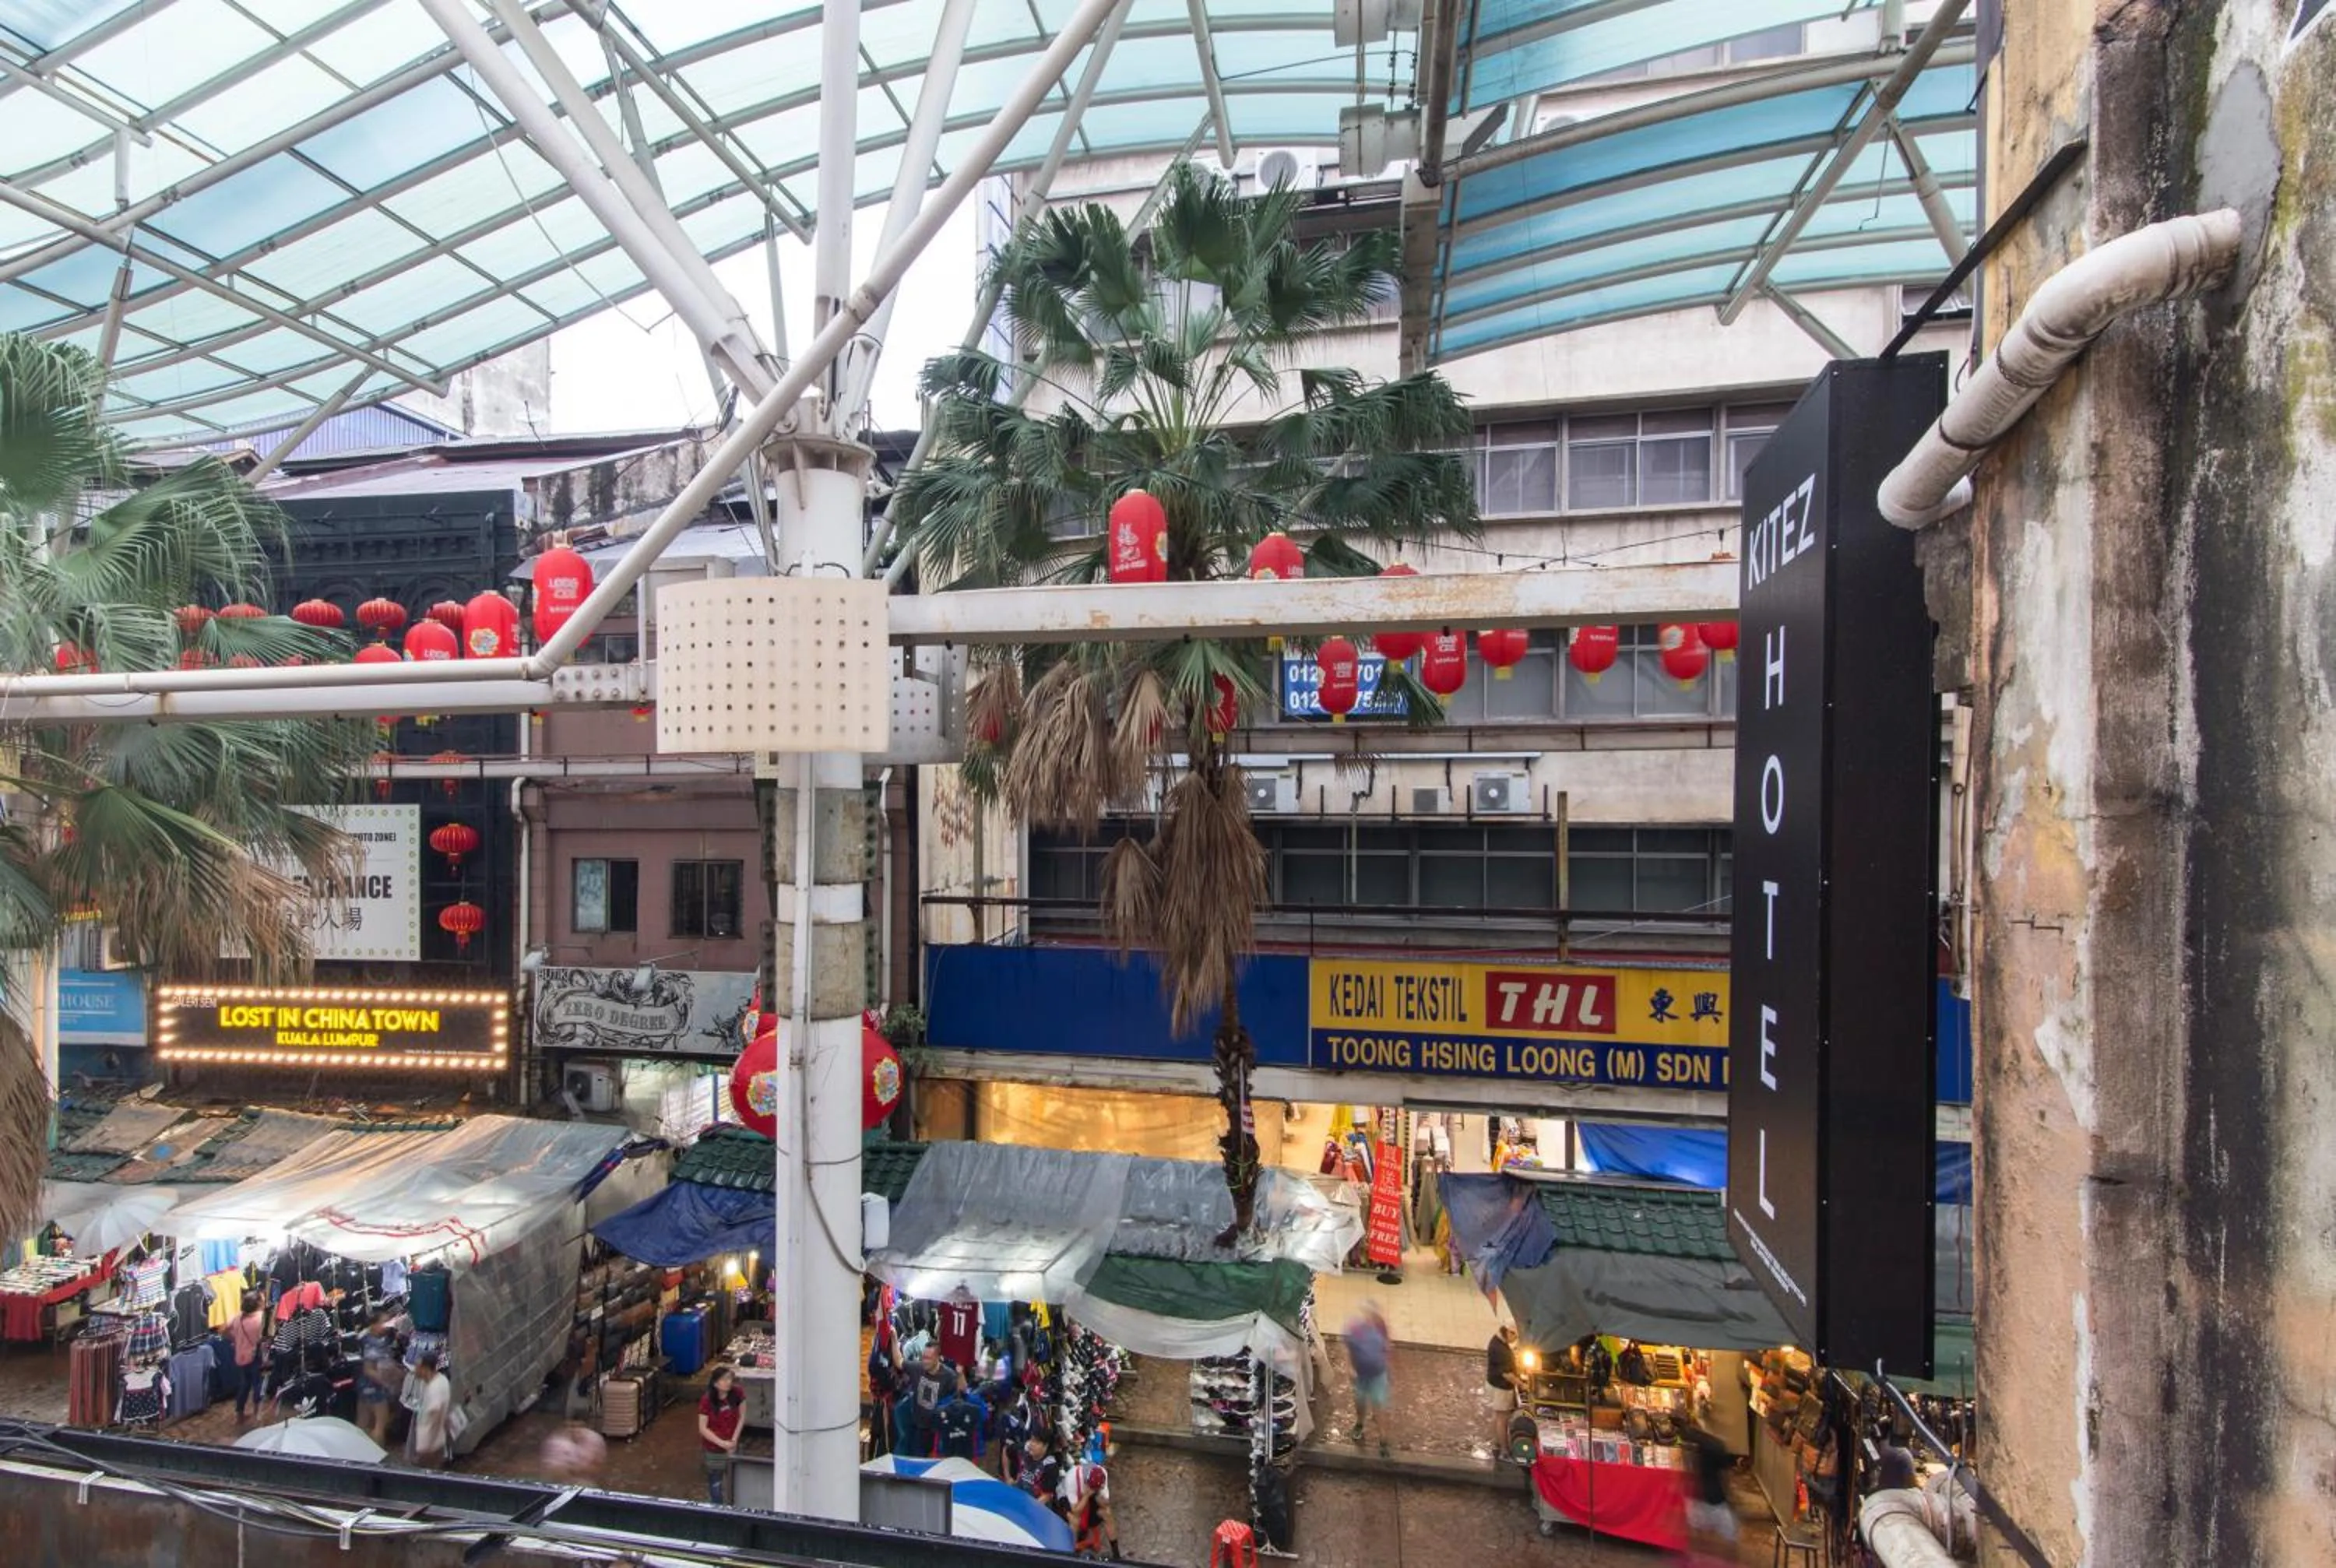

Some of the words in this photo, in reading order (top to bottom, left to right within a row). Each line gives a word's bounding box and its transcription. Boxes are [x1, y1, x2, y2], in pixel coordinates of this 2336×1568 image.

[1748, 473, 1815, 591] KITEZ
[1759, 625, 1785, 1221] HOTEL
[61, 993, 115, 1011] HOUSE
[1330, 974, 1384, 1018] KEDAI
[1395, 976, 1468, 1022] TEKSTIL
[1498, 982, 1602, 1026] THL
[220, 1006, 275, 1028] LOST
[277, 1007, 301, 1028] IN
[563, 1001, 602, 1021] ZERO
[610, 1010, 668, 1030] DEGREE
[276, 1031, 321, 1046] KUALA
[323, 1032, 379, 1047] LUMPUR
[1327, 1036, 1412, 1067] TOONG
[1421, 1040, 1497, 1072] HSING
[1507, 1045, 1596, 1077] LOONG
[1606, 1048, 1645, 1082] (M)
[1656, 1053, 1712, 1083] SDN
[1373, 1204, 1398, 1220] BUY
[1370, 1229, 1399, 1246] FREE
